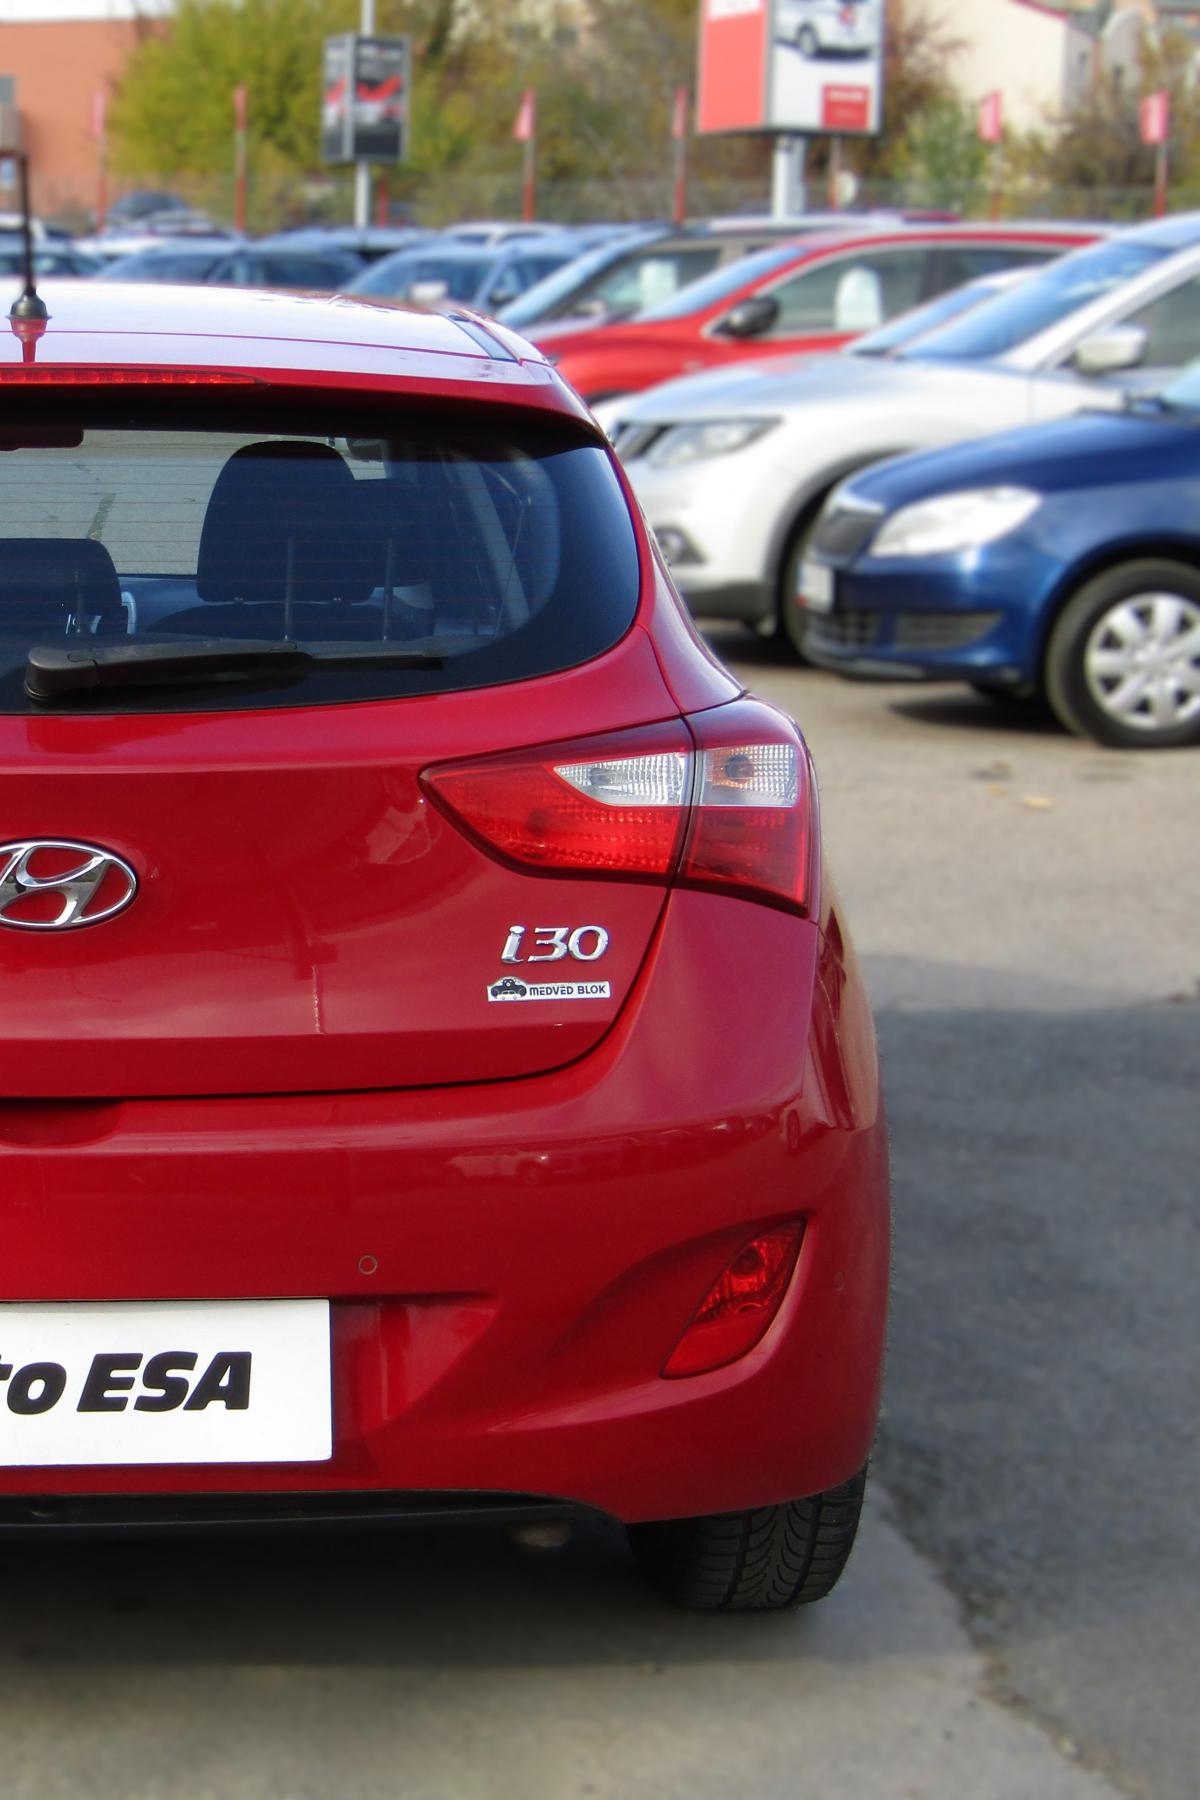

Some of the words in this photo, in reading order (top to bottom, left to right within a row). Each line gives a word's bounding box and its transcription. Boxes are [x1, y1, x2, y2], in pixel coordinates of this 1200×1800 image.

[501, 925, 609, 963] i30
[577, 985, 606, 995] BLOK
[76, 1350, 252, 1412] ESA
